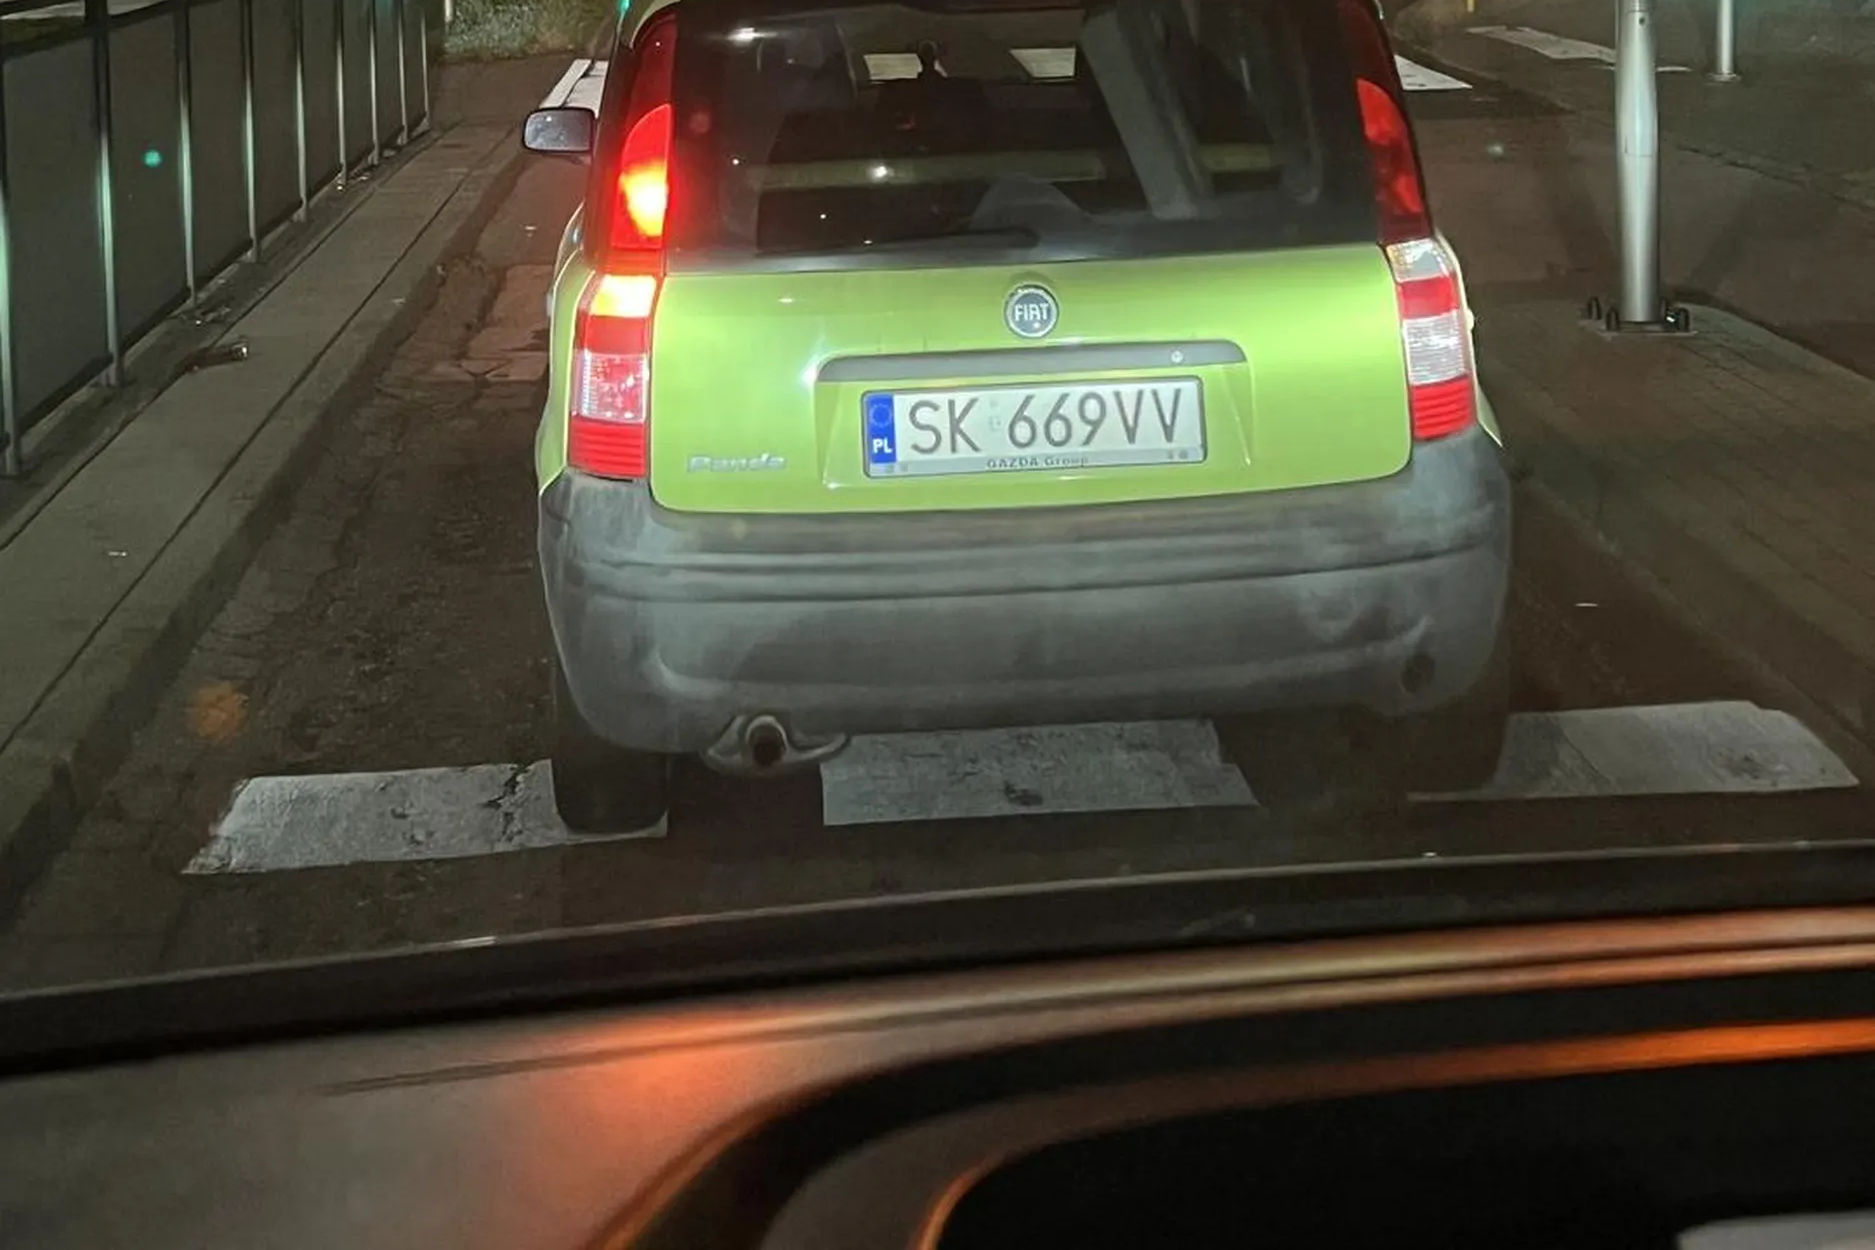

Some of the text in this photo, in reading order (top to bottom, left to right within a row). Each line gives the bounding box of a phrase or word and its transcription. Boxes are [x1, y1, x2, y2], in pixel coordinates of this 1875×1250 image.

[1015, 302, 1049, 322] FIAT
[908, 388, 1182, 455] SK 669VV
[873, 437, 892, 453] PL
[987, 457, 1039, 468] GAZDA
